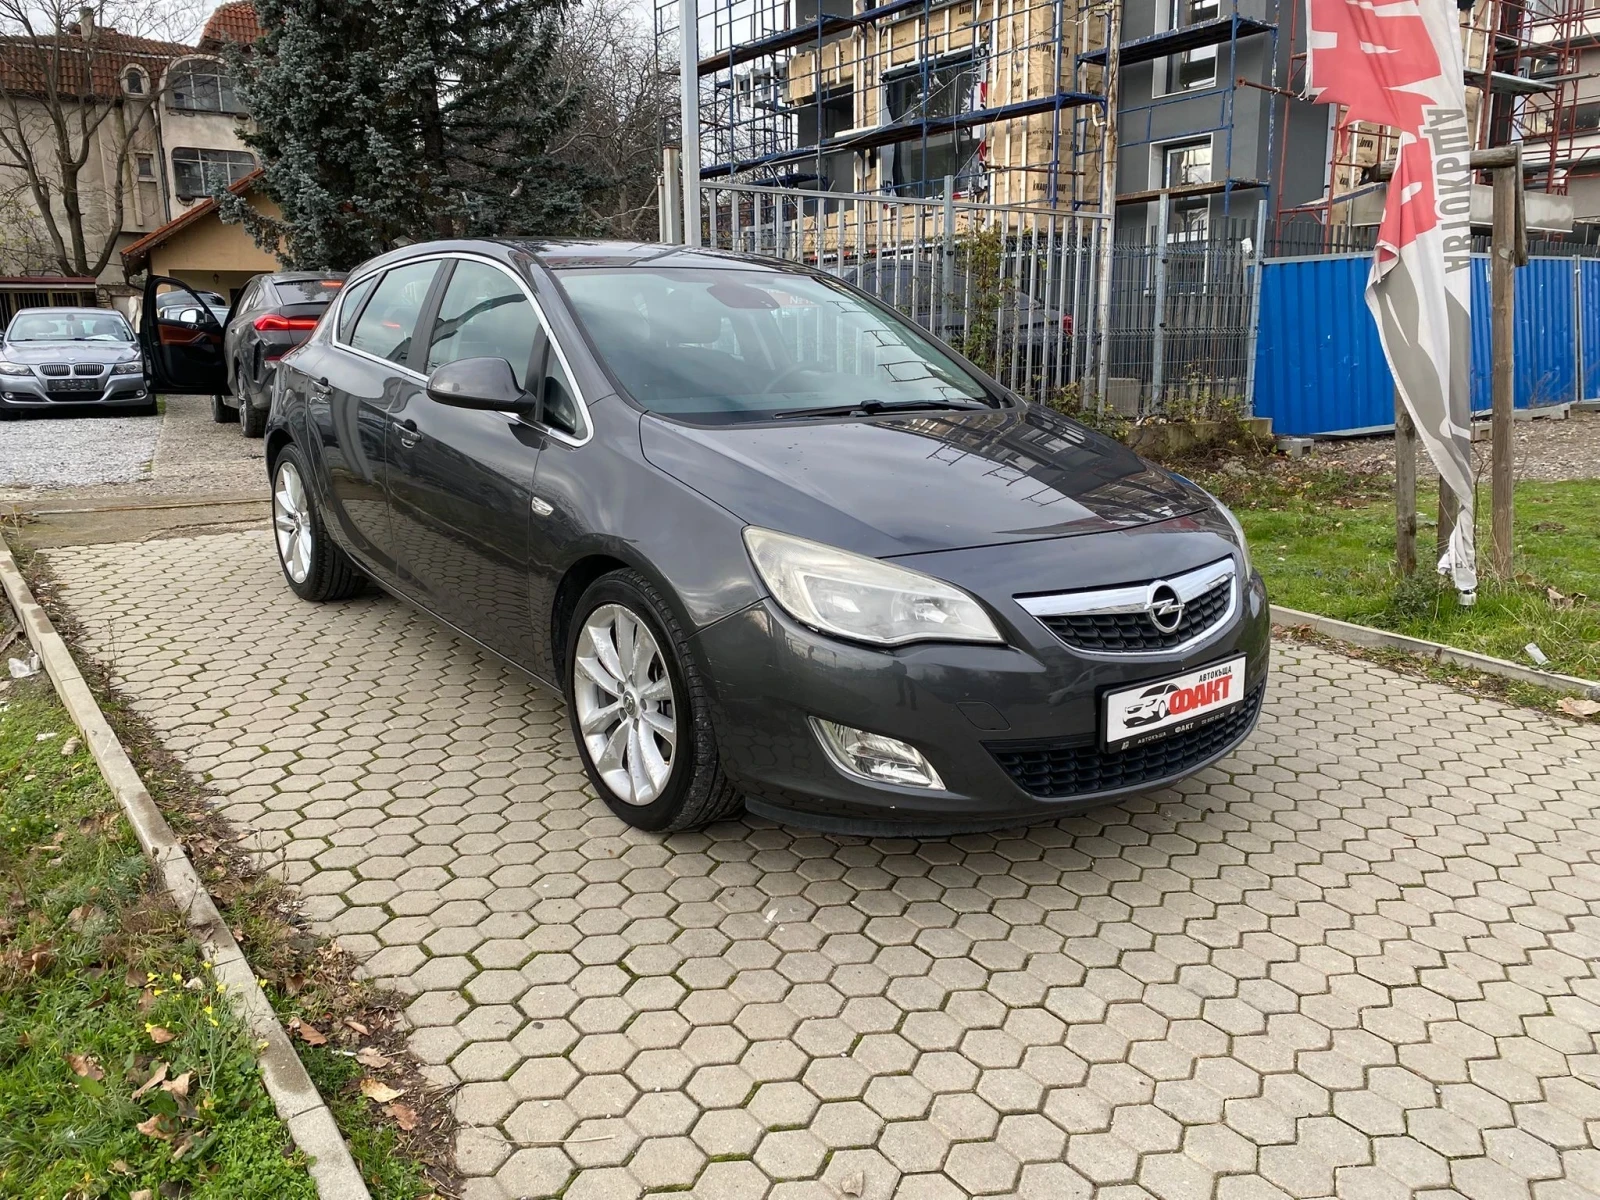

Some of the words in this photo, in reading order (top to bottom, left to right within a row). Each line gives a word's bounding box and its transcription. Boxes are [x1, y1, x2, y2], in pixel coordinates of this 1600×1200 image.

[1199, 665, 1232, 682] АВТОКЪЩА
[1169, 674, 1233, 715] ФАКТ
[1174, 722, 1194, 733] ФАКТ
